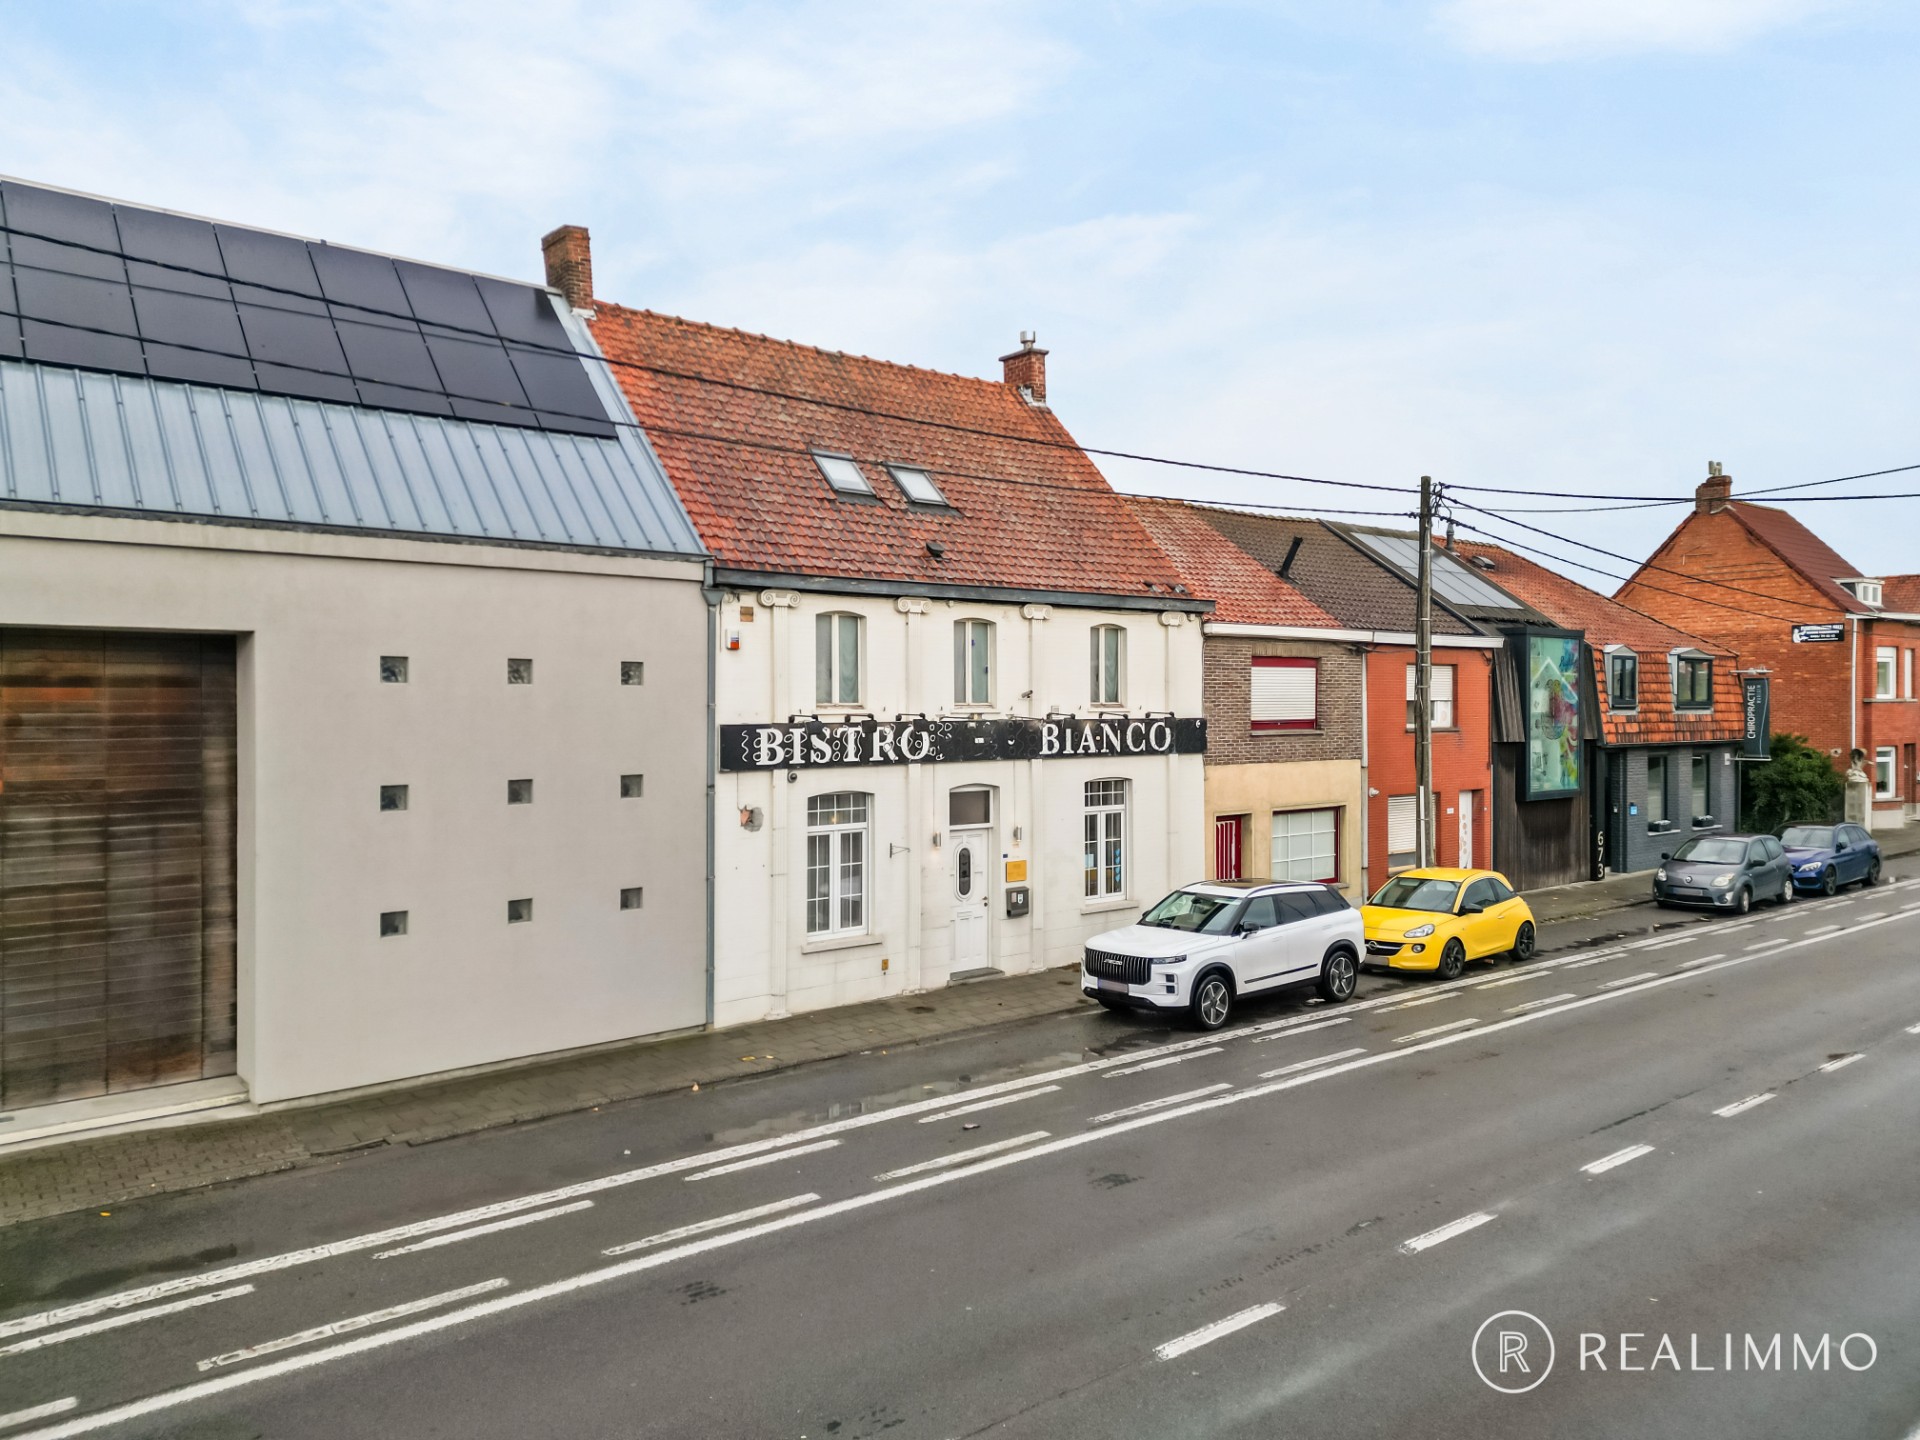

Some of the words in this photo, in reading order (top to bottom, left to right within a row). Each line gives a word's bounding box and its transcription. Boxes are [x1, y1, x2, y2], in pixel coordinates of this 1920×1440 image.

[1747, 685, 1756, 738] CHIROPRACTIE
[756, 727, 929, 765] BISTRO
[1038, 722, 1171, 755] BIANCO
